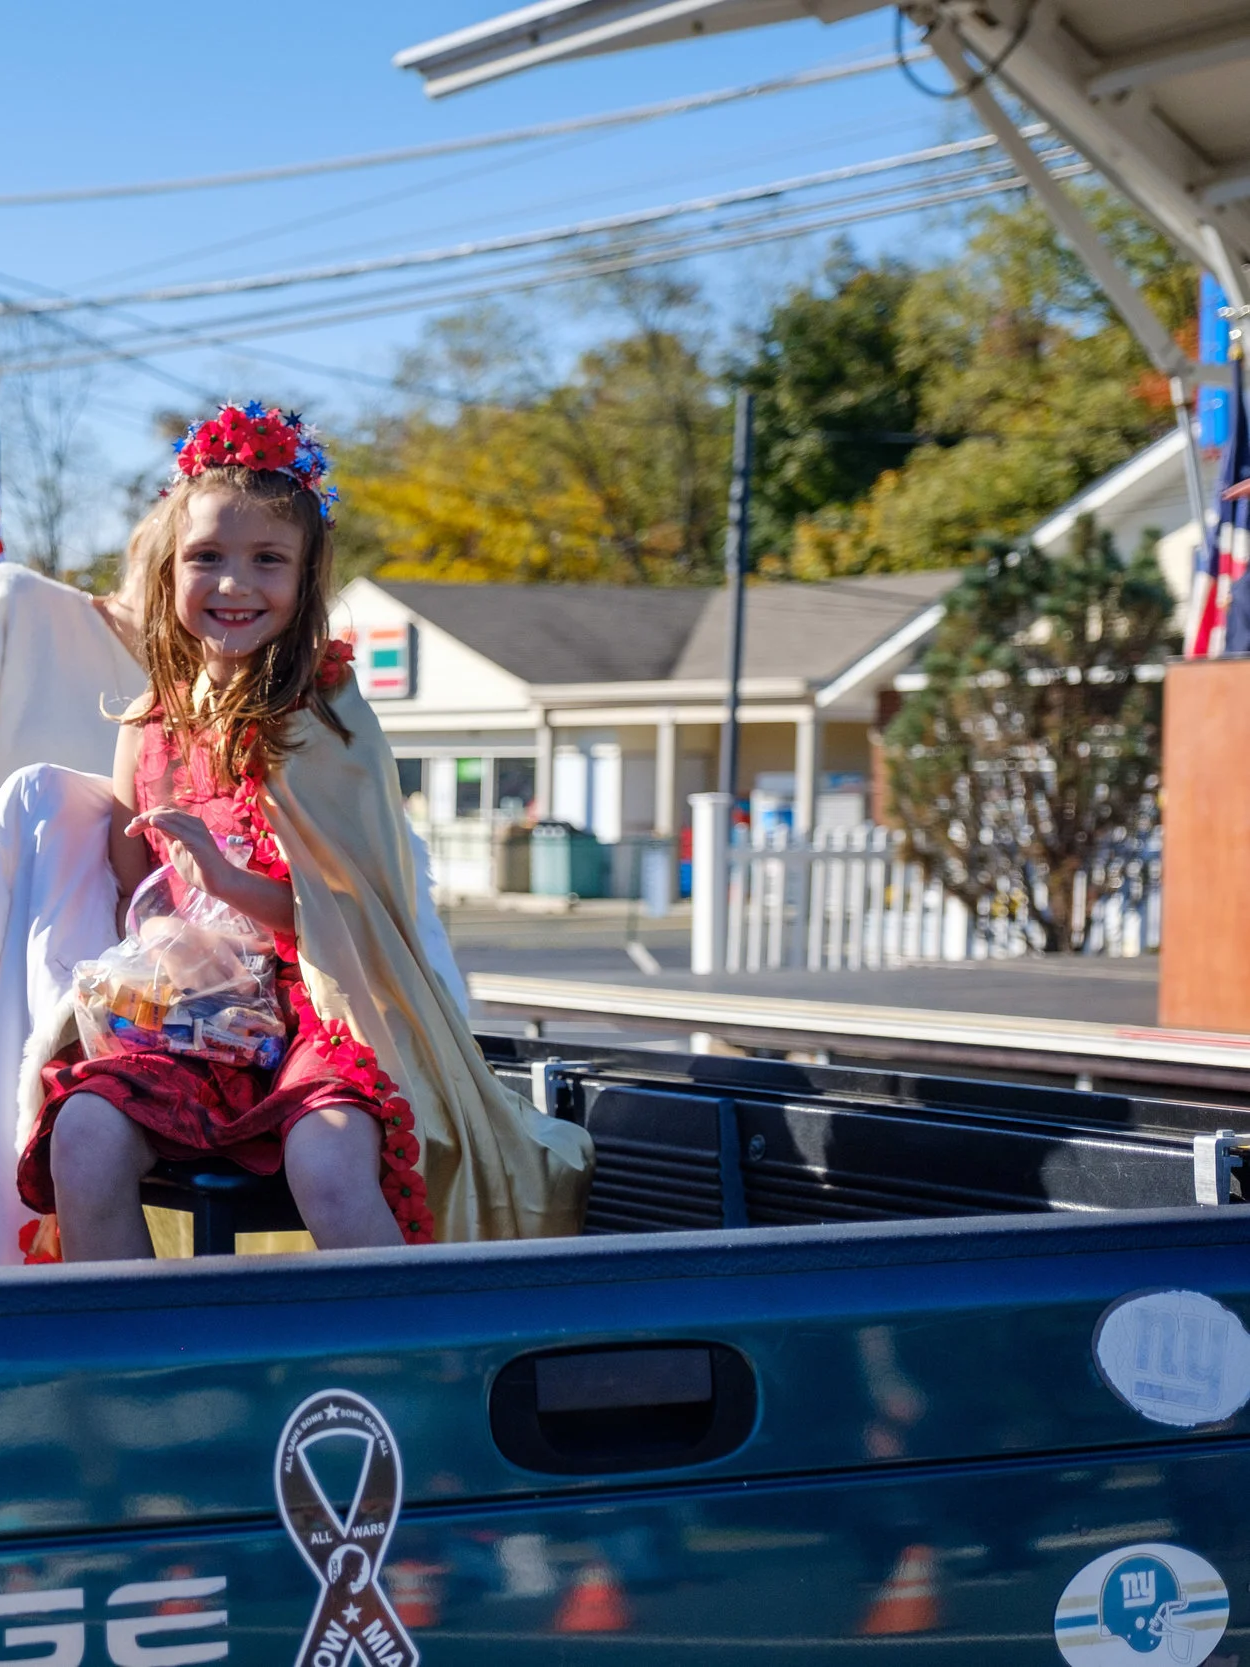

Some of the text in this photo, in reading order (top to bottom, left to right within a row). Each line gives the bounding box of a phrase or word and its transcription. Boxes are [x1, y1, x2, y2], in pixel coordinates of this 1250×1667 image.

[287, 1427, 303, 1454] GAVE
[300, 1411, 324, 1430] SOME
[340, 1408, 364, 1422] SOME
[364, 1416, 383, 1439] GAVE
[310, 1522, 386, 1545] ALL WARS
[313, 1618, 349, 1667] OW
[361, 1618, 403, 1667] MIA
